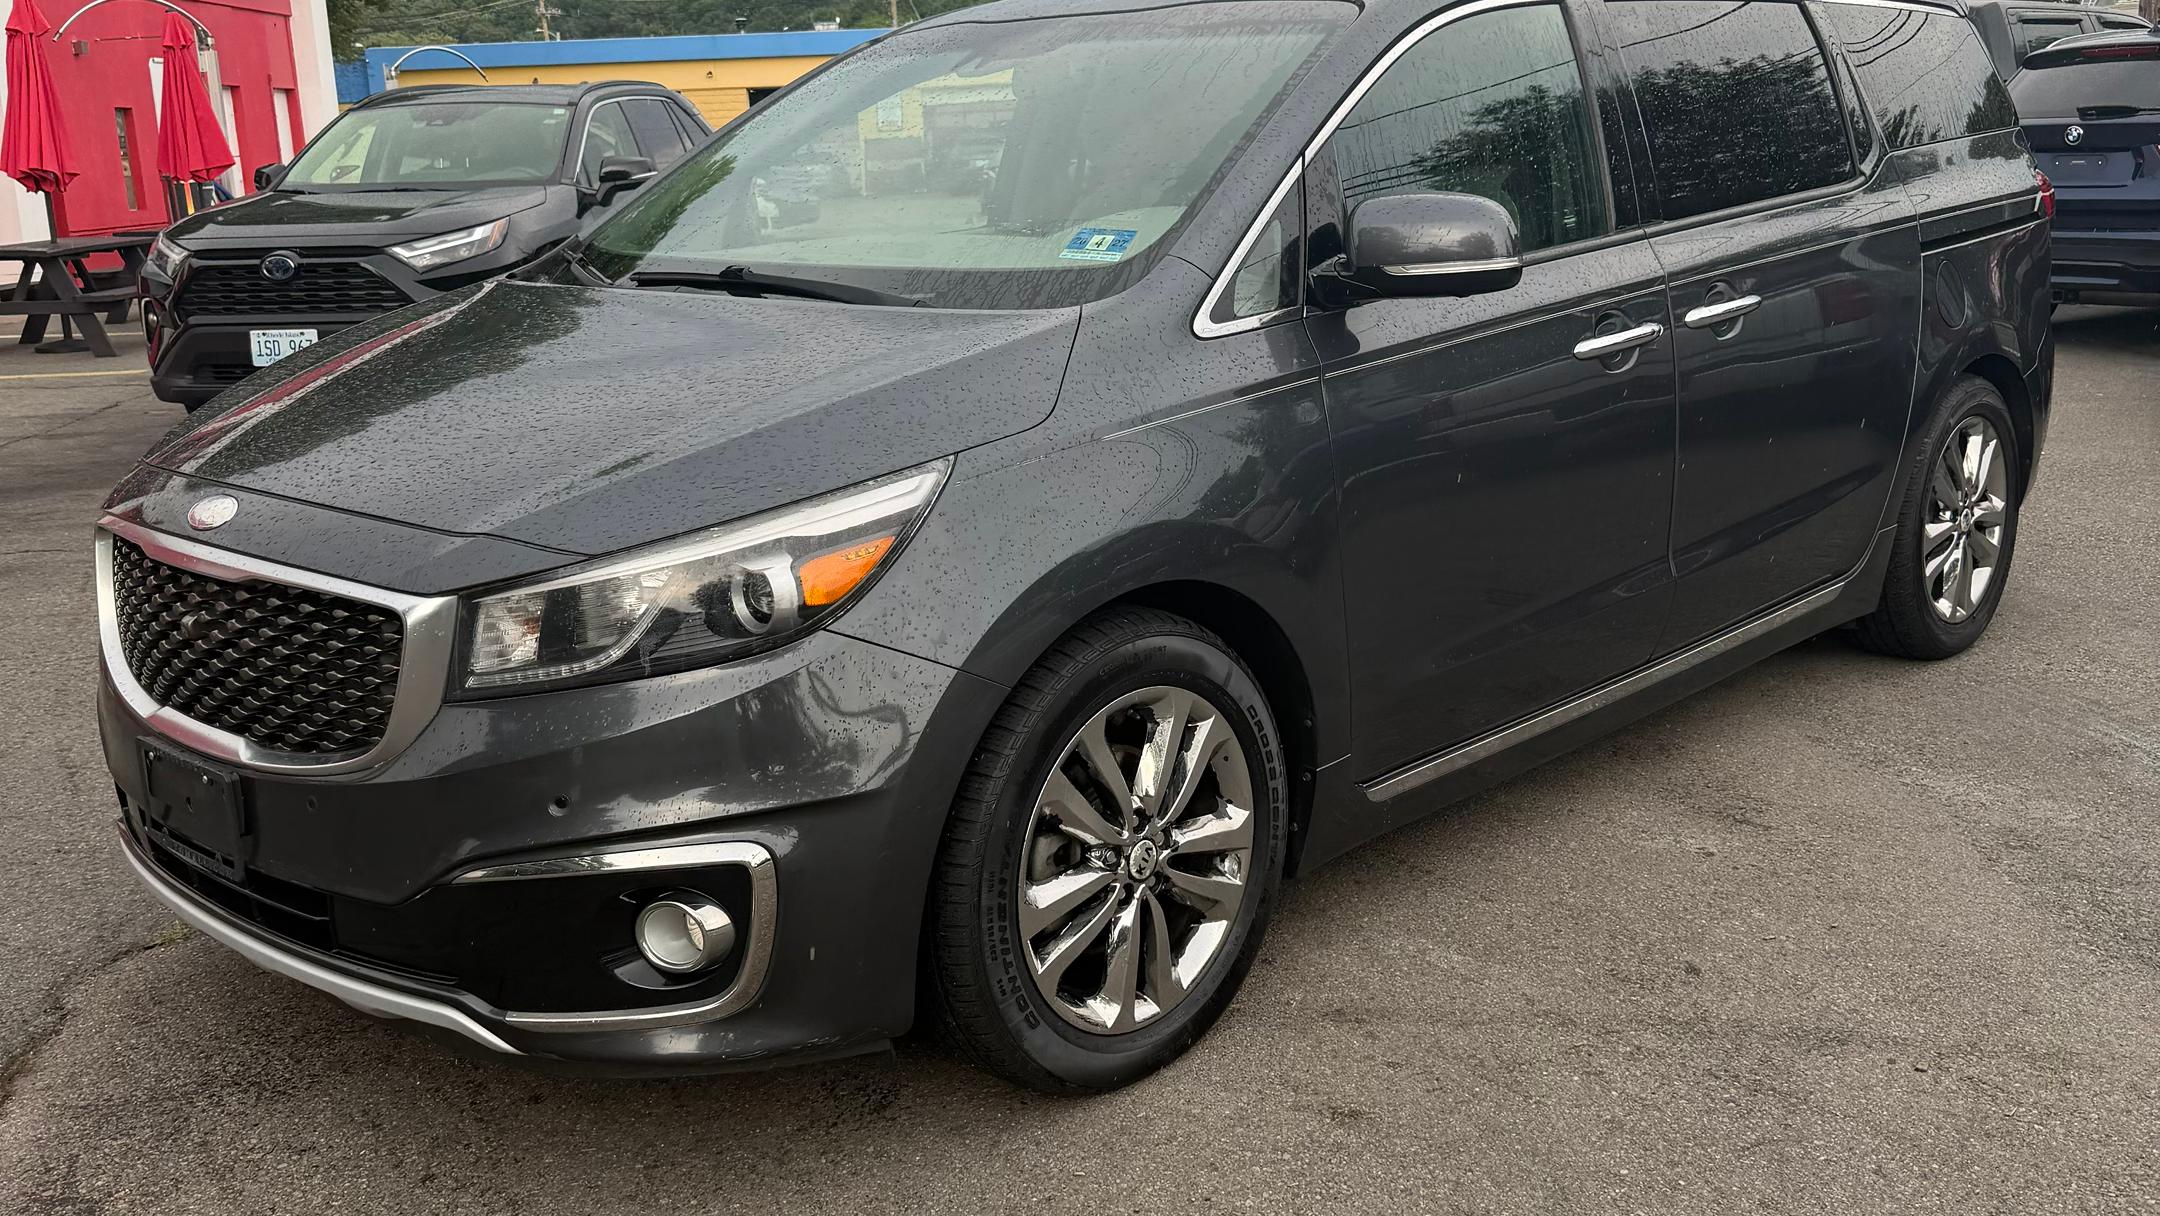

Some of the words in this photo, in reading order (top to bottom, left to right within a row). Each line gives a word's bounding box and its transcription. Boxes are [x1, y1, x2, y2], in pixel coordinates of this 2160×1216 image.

[1095, 236, 1106, 248] 4
[257, 340, 281, 357] 1SD
[1135, 847, 1153, 875] KIA
